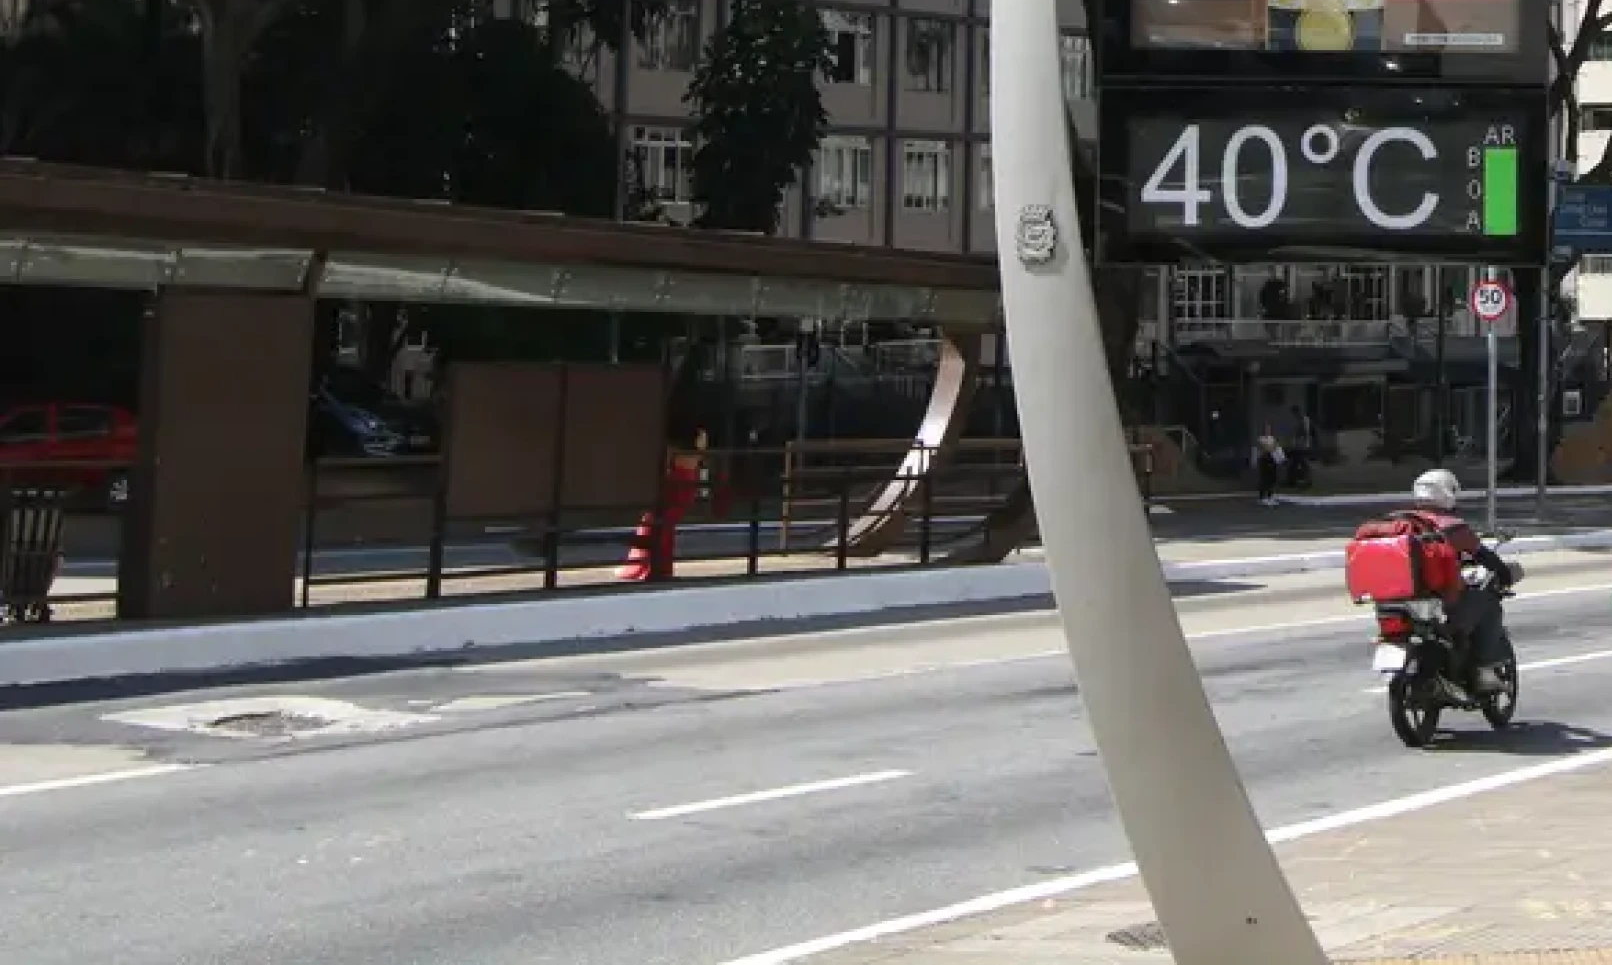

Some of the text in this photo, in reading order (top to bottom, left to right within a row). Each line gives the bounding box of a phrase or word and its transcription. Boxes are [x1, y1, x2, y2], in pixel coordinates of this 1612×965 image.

[1485, 125, 1515, 145] AR
[1141, 124, 1439, 229] 40°C
[1479, 288, 1502, 305] 50
